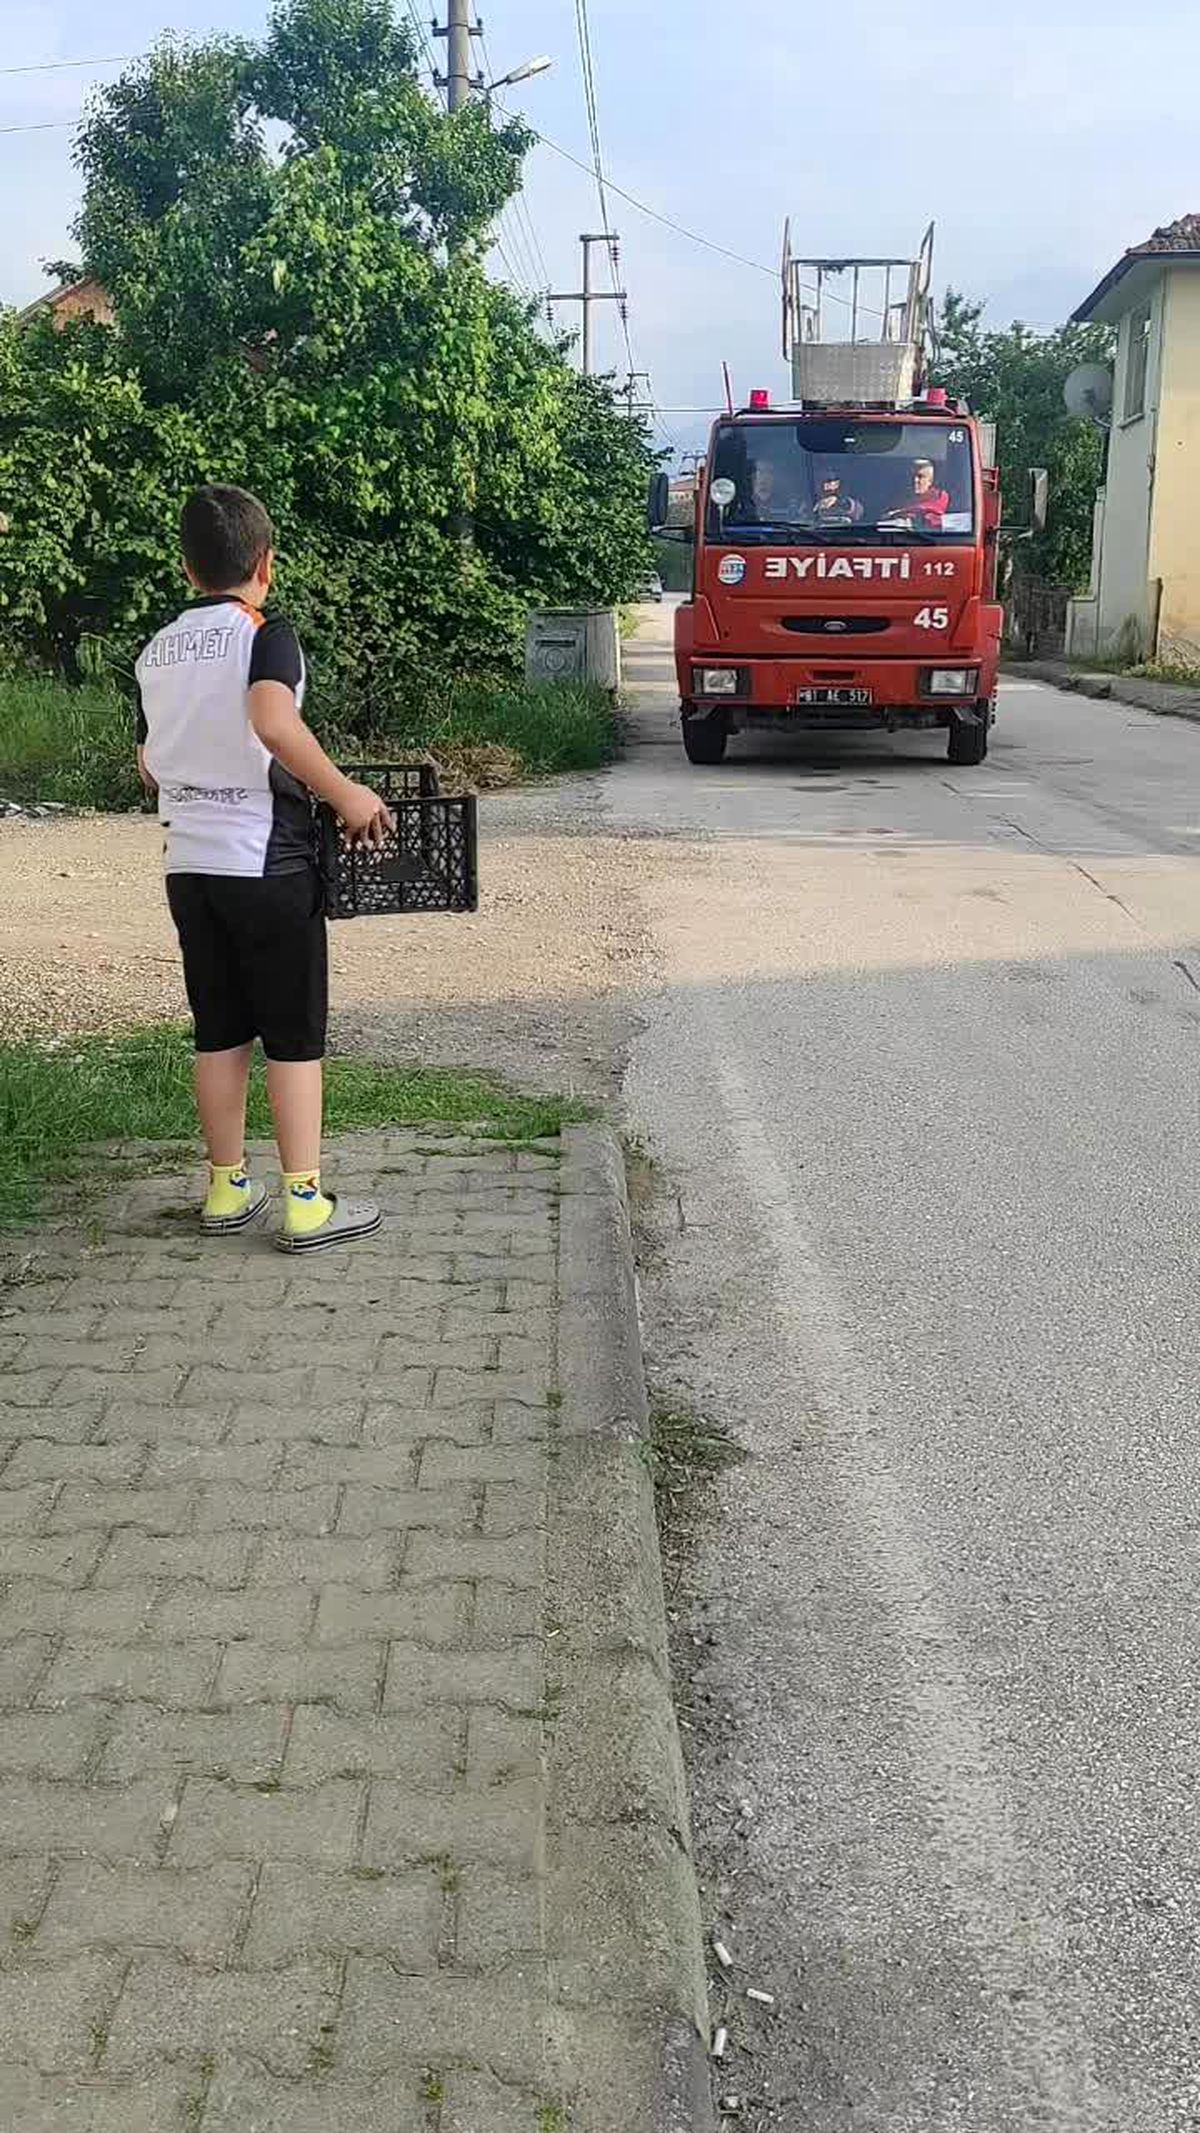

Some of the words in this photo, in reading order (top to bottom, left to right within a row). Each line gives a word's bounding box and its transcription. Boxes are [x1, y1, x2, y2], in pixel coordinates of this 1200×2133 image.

[948, 430, 965, 443] 45
[922, 562, 955, 577] 112
[913, 607, 949, 630] 45
[144, 626, 235, 668] AHMET
